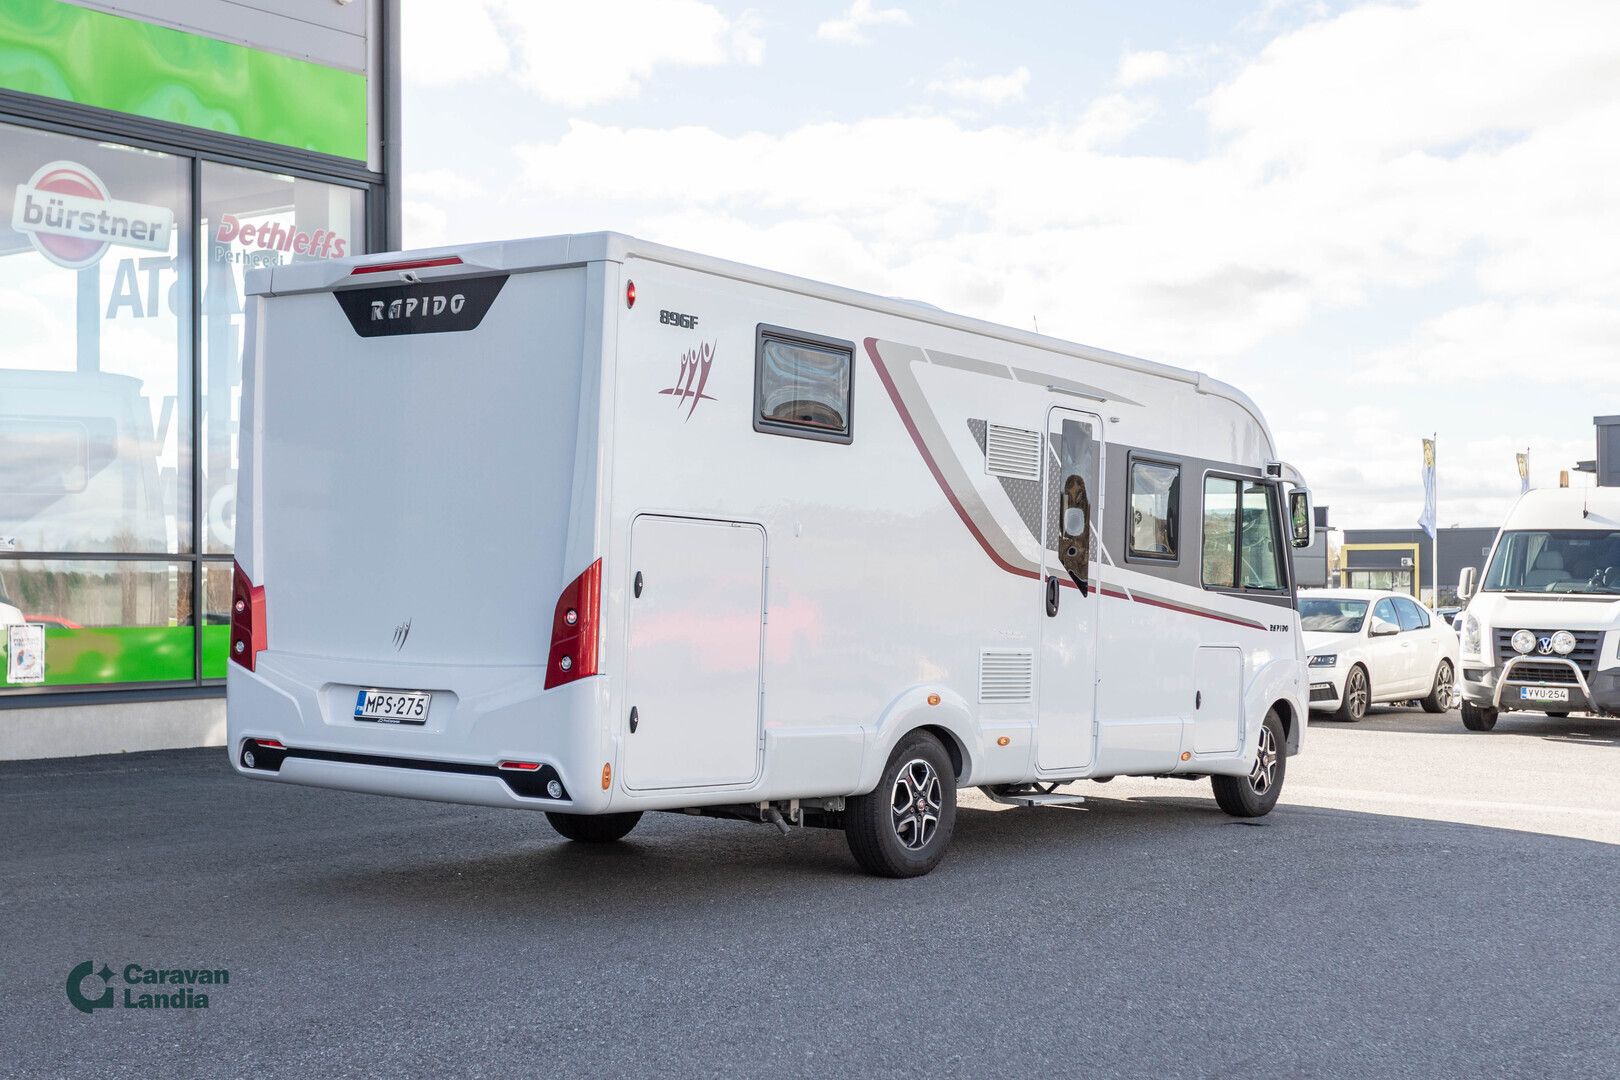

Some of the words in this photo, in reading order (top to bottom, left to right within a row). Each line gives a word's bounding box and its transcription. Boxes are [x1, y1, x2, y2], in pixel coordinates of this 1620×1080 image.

[24, 195, 161, 241] bürstner
[217, 215, 346, 259] Dethleffs
[371, 294, 465, 320] RAPIDO
[660, 310, 698, 329] 896F
[365, 696, 424, 716] MPS-275
